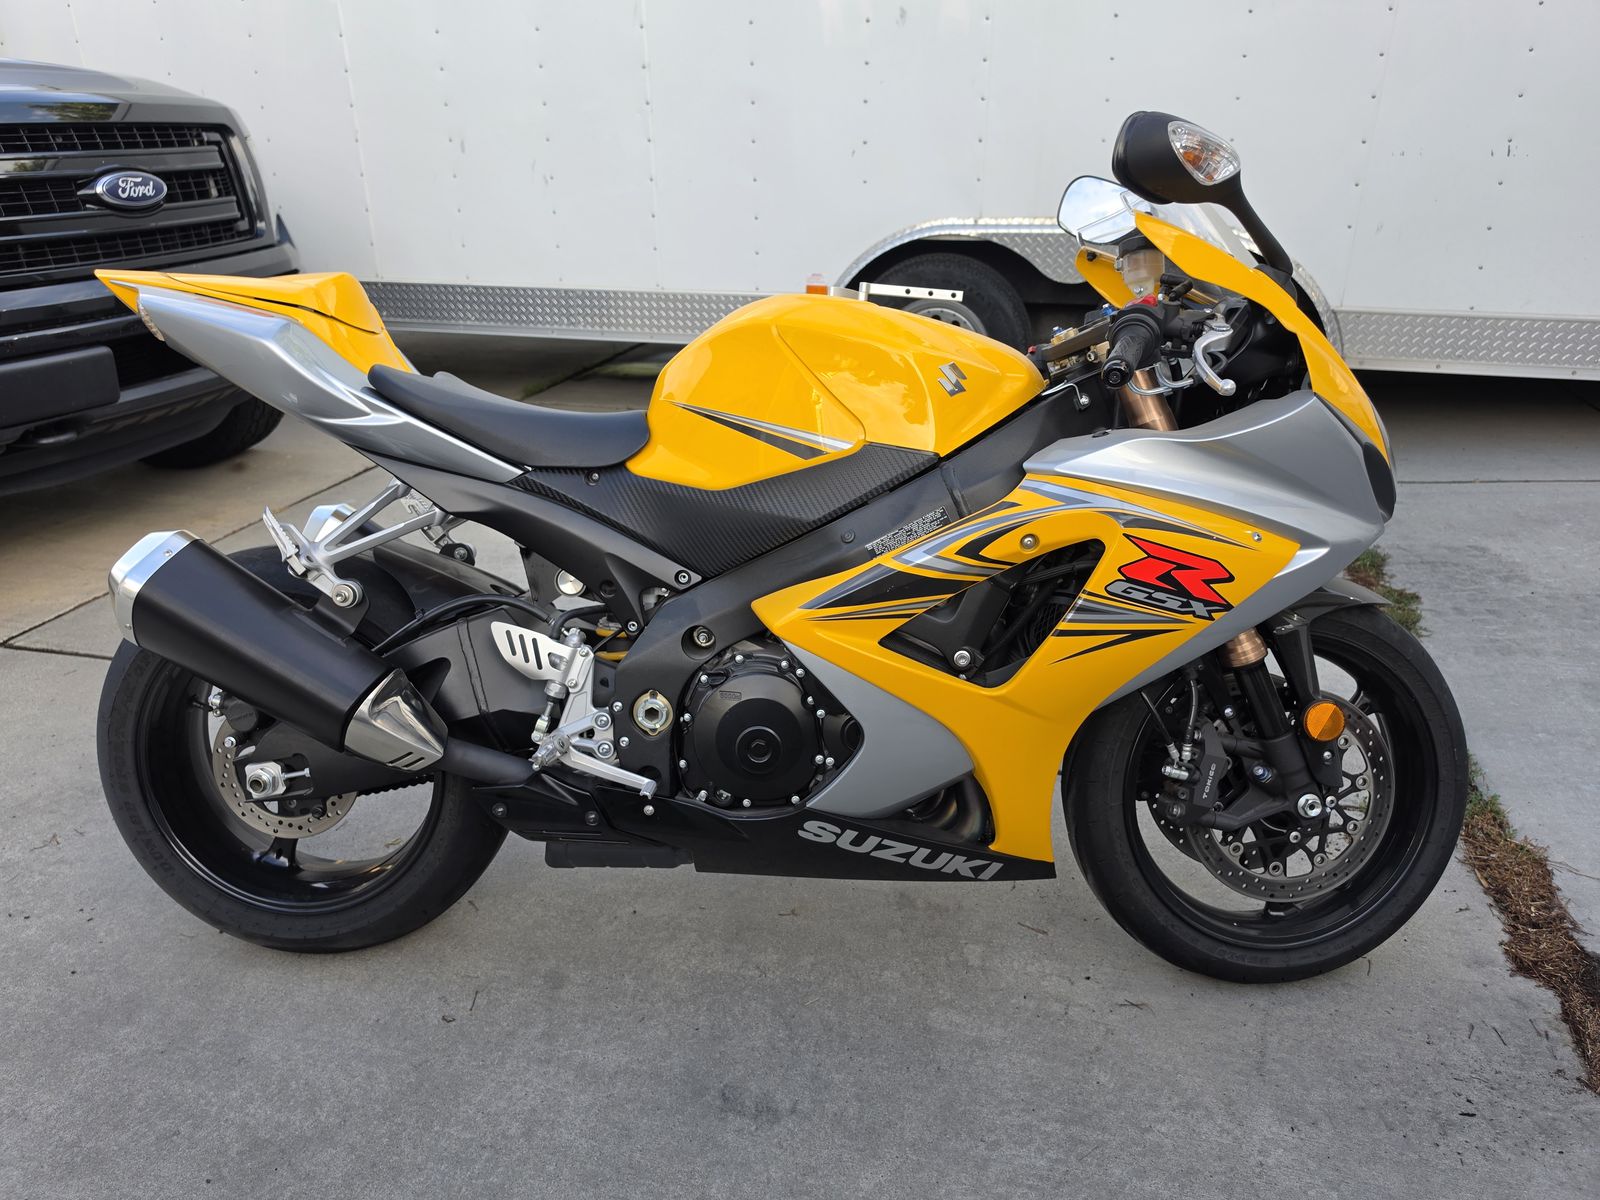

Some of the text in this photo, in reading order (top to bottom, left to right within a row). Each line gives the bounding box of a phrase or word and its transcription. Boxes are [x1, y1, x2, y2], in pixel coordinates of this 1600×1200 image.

[118, 177, 156, 199] Ford
[1202, 762, 1217, 800] TOKICO
[797, 820, 1004, 880] SUZUKI
